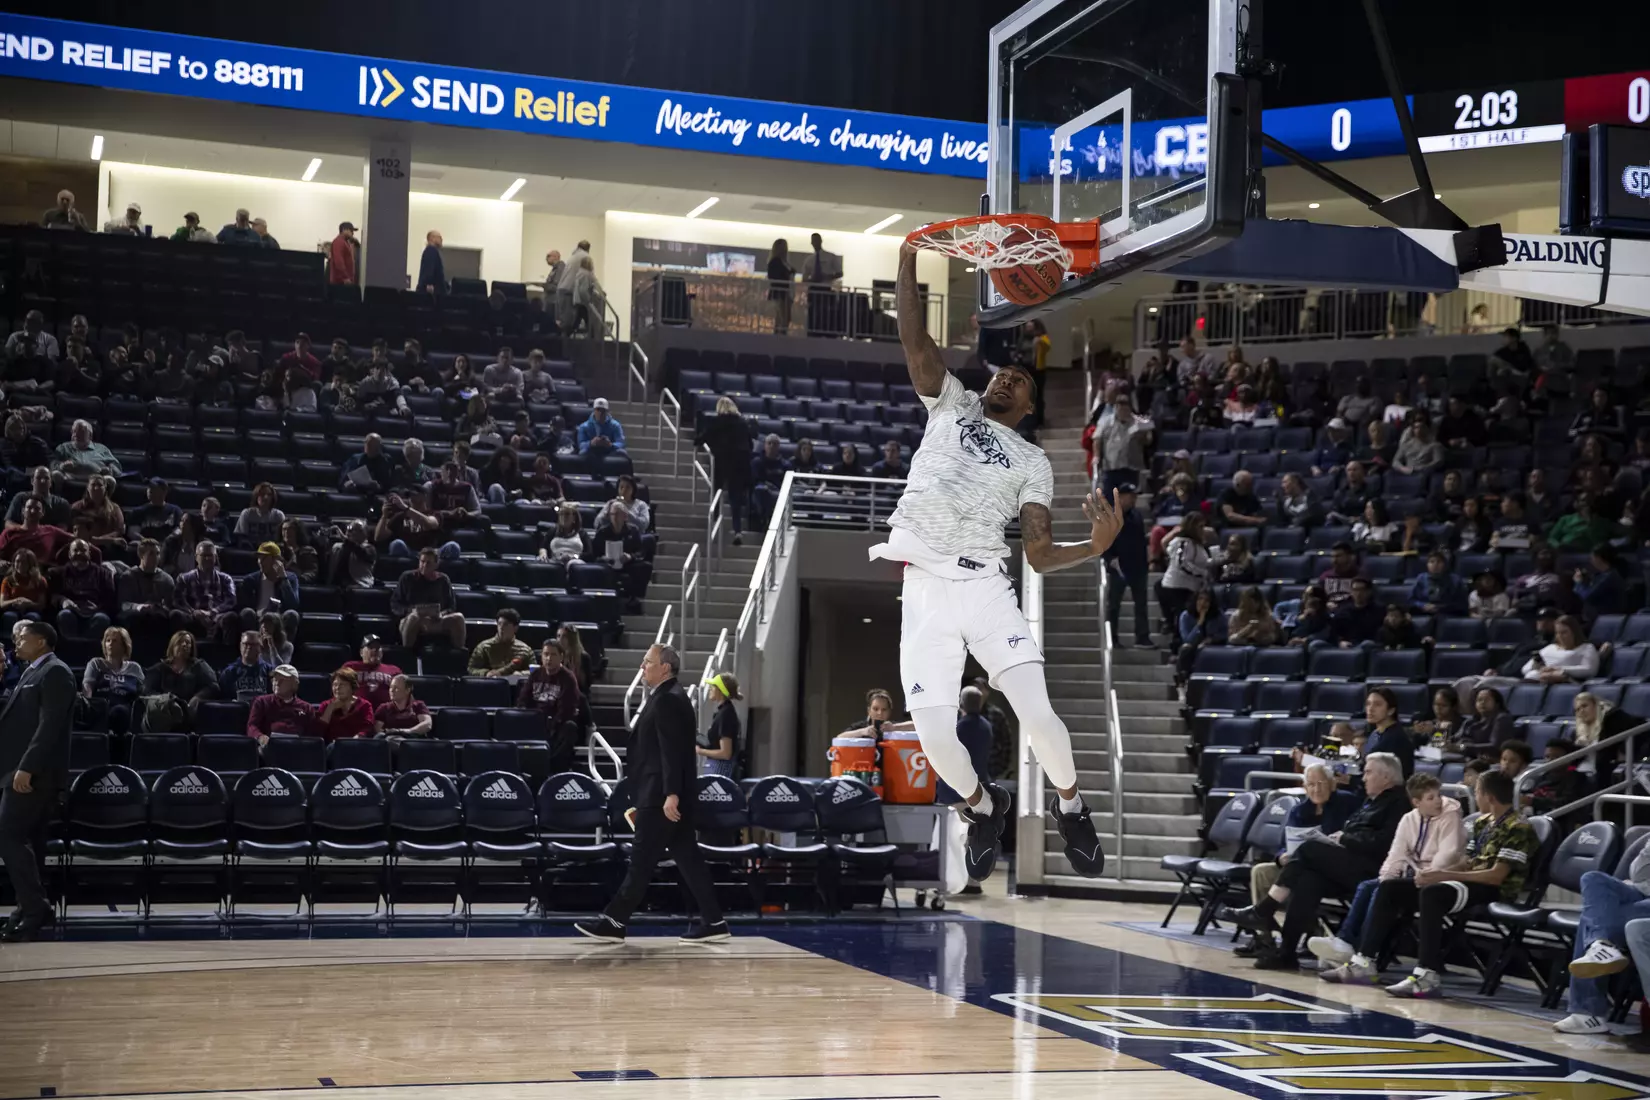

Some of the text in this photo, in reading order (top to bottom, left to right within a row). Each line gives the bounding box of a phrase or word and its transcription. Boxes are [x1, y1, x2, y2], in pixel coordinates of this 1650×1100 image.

[0, 32, 303, 91] ND RELIEF to 888111
[411, 75, 611, 127] SEND Relief
[1628, 77, 1650, 124] 0
[1454, 89, 1518, 130] 2:03
[655, 98, 988, 165] Meeting needs, changing lives
[1331, 107, 1351, 151] 0
[1450, 128, 1529, 149] 1ST HALF
[381, 158, 400, 168] 102
[381, 169, 400, 179] 103
[910, 751, 927, 770] G
[89, 784, 130, 794] adidas
[169, 784, 210, 794] adidas
[252, 786, 290, 797] adidas
[331, 787, 368, 797] adidas
[408, 788, 445, 798] adidas
[481, 789, 518, 800] adidas
[555, 791, 591, 800] adidas
[698, 792, 732, 802] adidas
[765, 793, 800, 803] adidas
[832, 788, 863, 804] adidas
